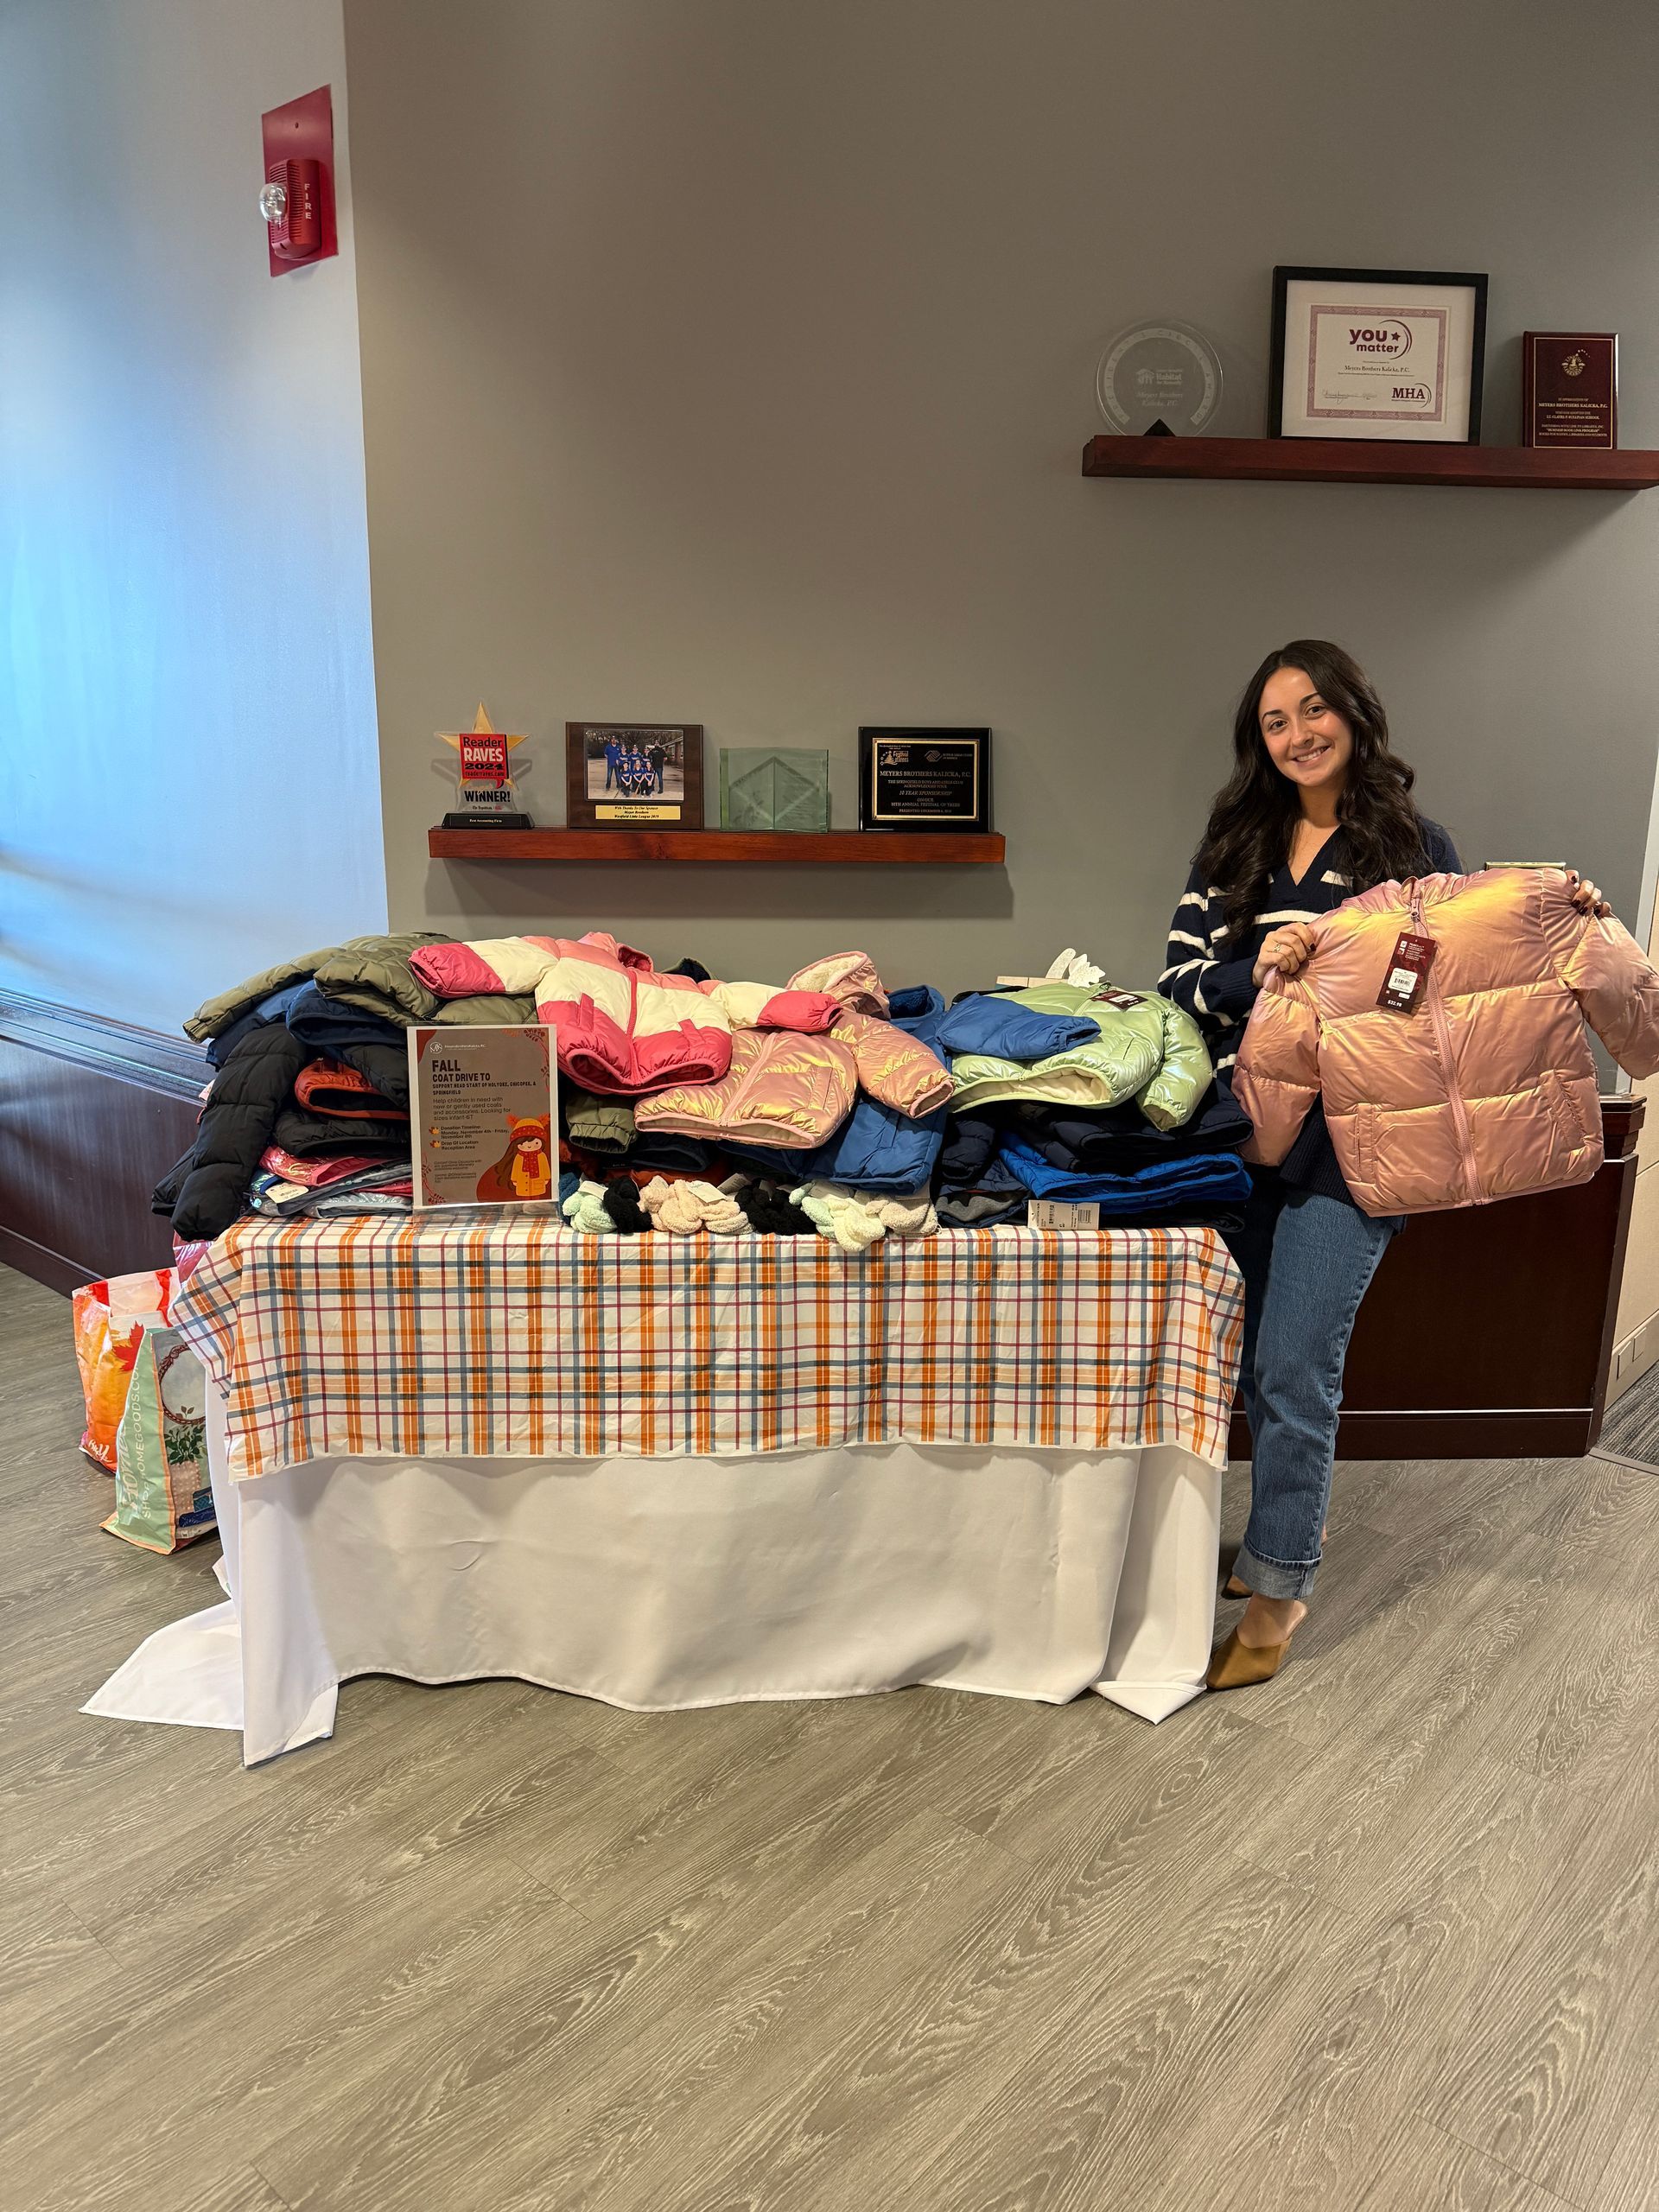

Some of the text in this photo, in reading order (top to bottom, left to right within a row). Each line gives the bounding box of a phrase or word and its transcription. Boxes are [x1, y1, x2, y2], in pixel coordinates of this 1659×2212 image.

[1349, 329, 1388, 345] you
[1357, 344, 1399, 353] matter
[1391, 387, 1426, 399] MHA
[463, 737, 502, 747] Reader
[464, 747, 504, 761] RAVES
[464, 791, 511, 802] WINNER!
[432, 1059, 461, 1071] FALL
[455, 1073, 478, 1082] DRIVE
[480, 1072, 490, 1081] TO
[142, 1481, 151, 1519] SHOP
